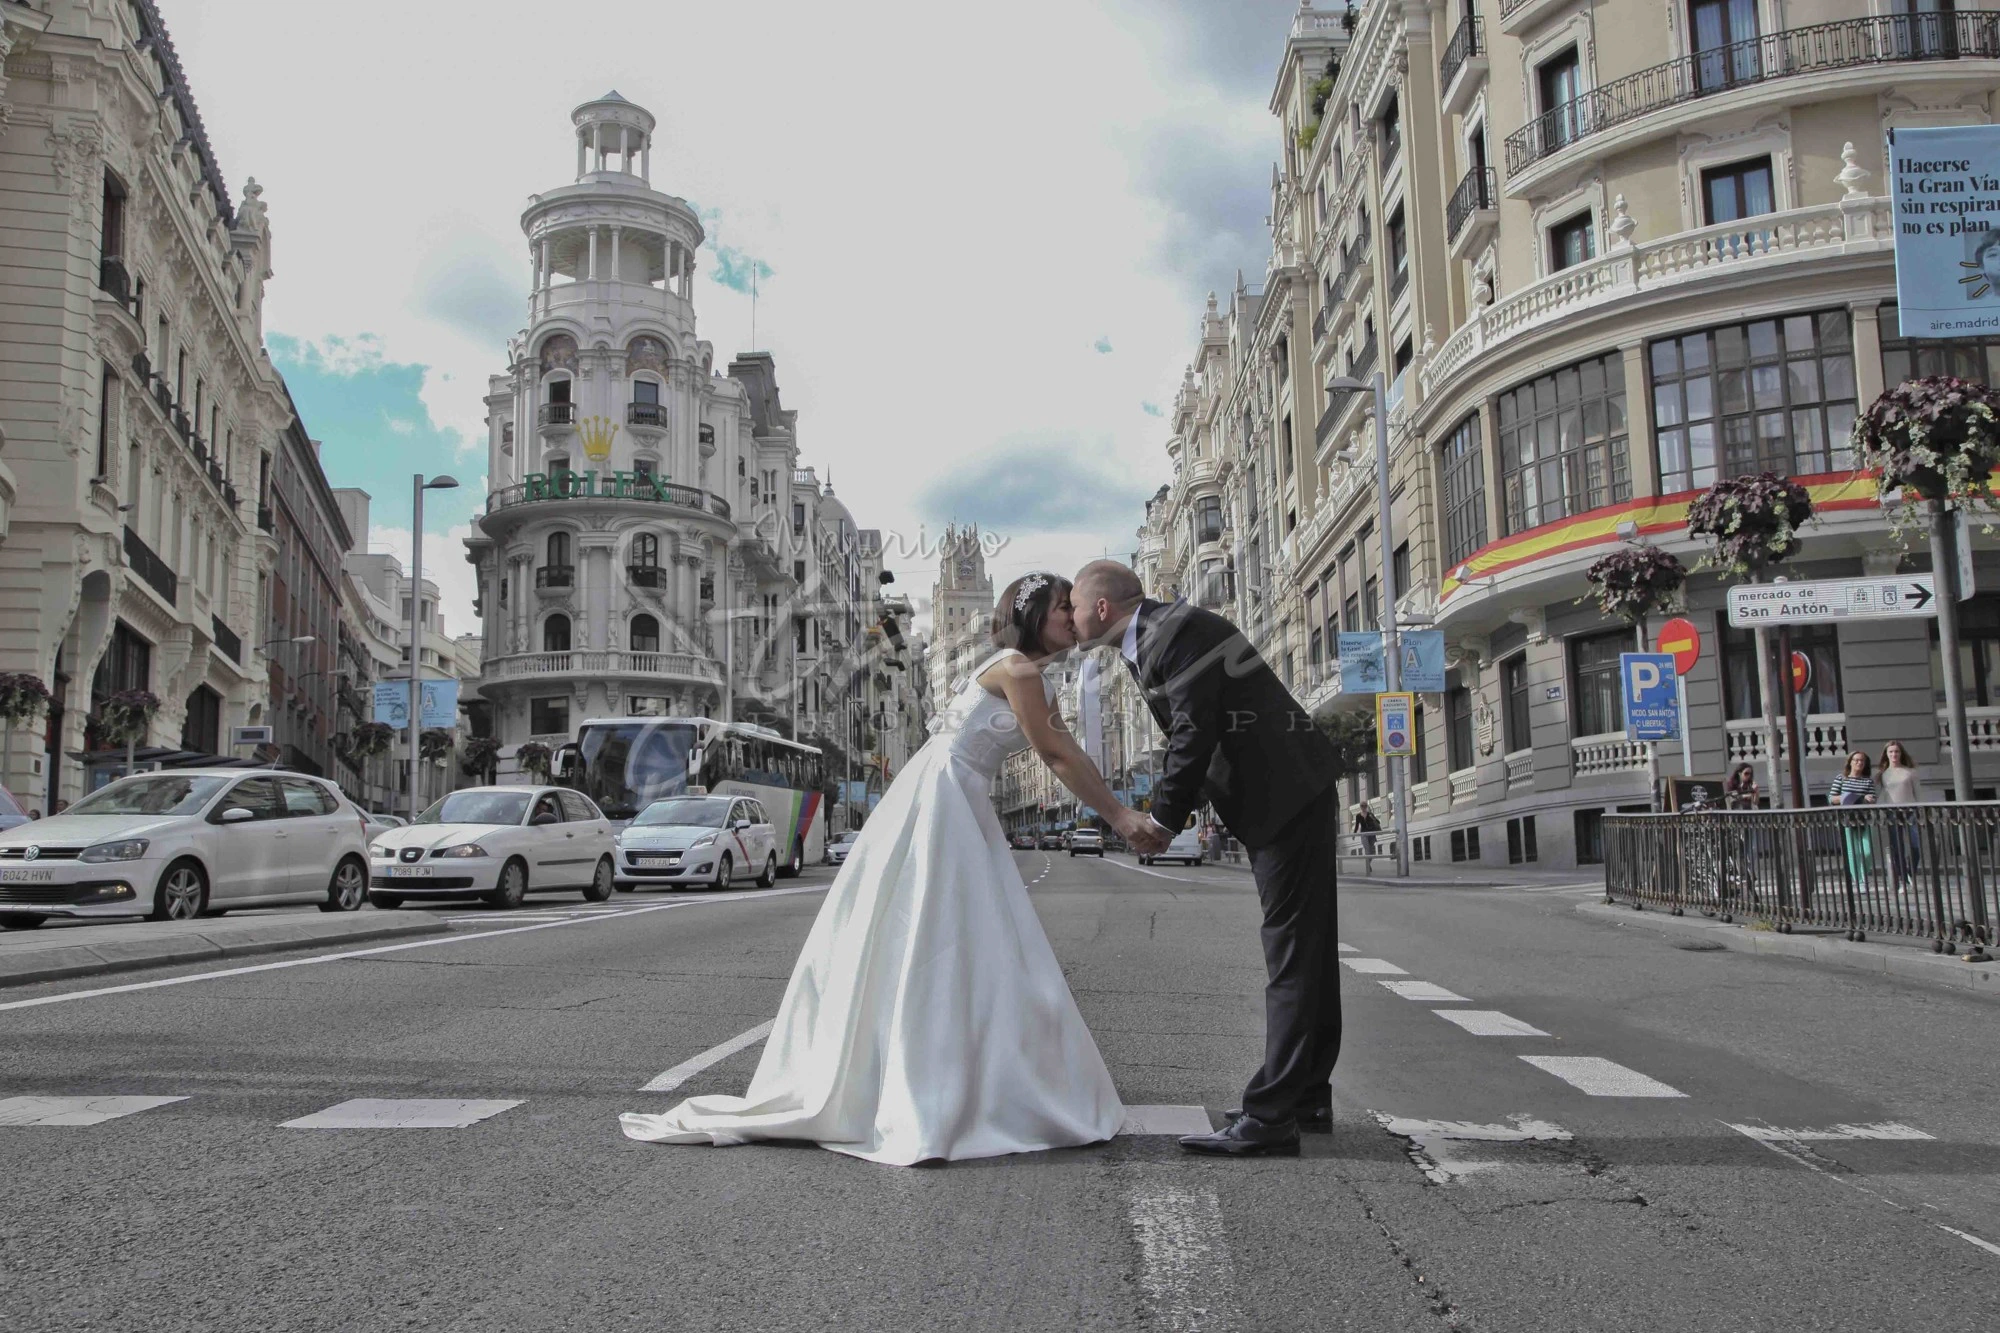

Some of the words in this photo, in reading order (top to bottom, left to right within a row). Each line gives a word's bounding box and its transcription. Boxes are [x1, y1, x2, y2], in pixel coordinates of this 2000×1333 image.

[1898, 157, 1970, 174] Hacerse
[1900, 178, 1914, 194] la
[1918, 177, 1964, 194] Gran
[1969, 174, 1999, 192] Vía
[1901, 198, 1925, 215] sin
[1902, 220, 1921, 235] no
[1926, 220, 1944, 235] es
[1950, 216, 1990, 236] plan
[1930, 316, 1999, 330] aire.madrid
[523, 469, 672, 502] ROLEX
[1738, 589, 1791, 601] mercado
[1798, 588, 1814, 598] de
[1739, 606, 1769, 618] San
[1780, 602, 1828, 617] Antón
[1630, 661, 1660, 703] P
[1647, 709, 1659, 717] SAN
[2, 870, 28, 881] 6042
[31, 870, 53, 881] HVN
